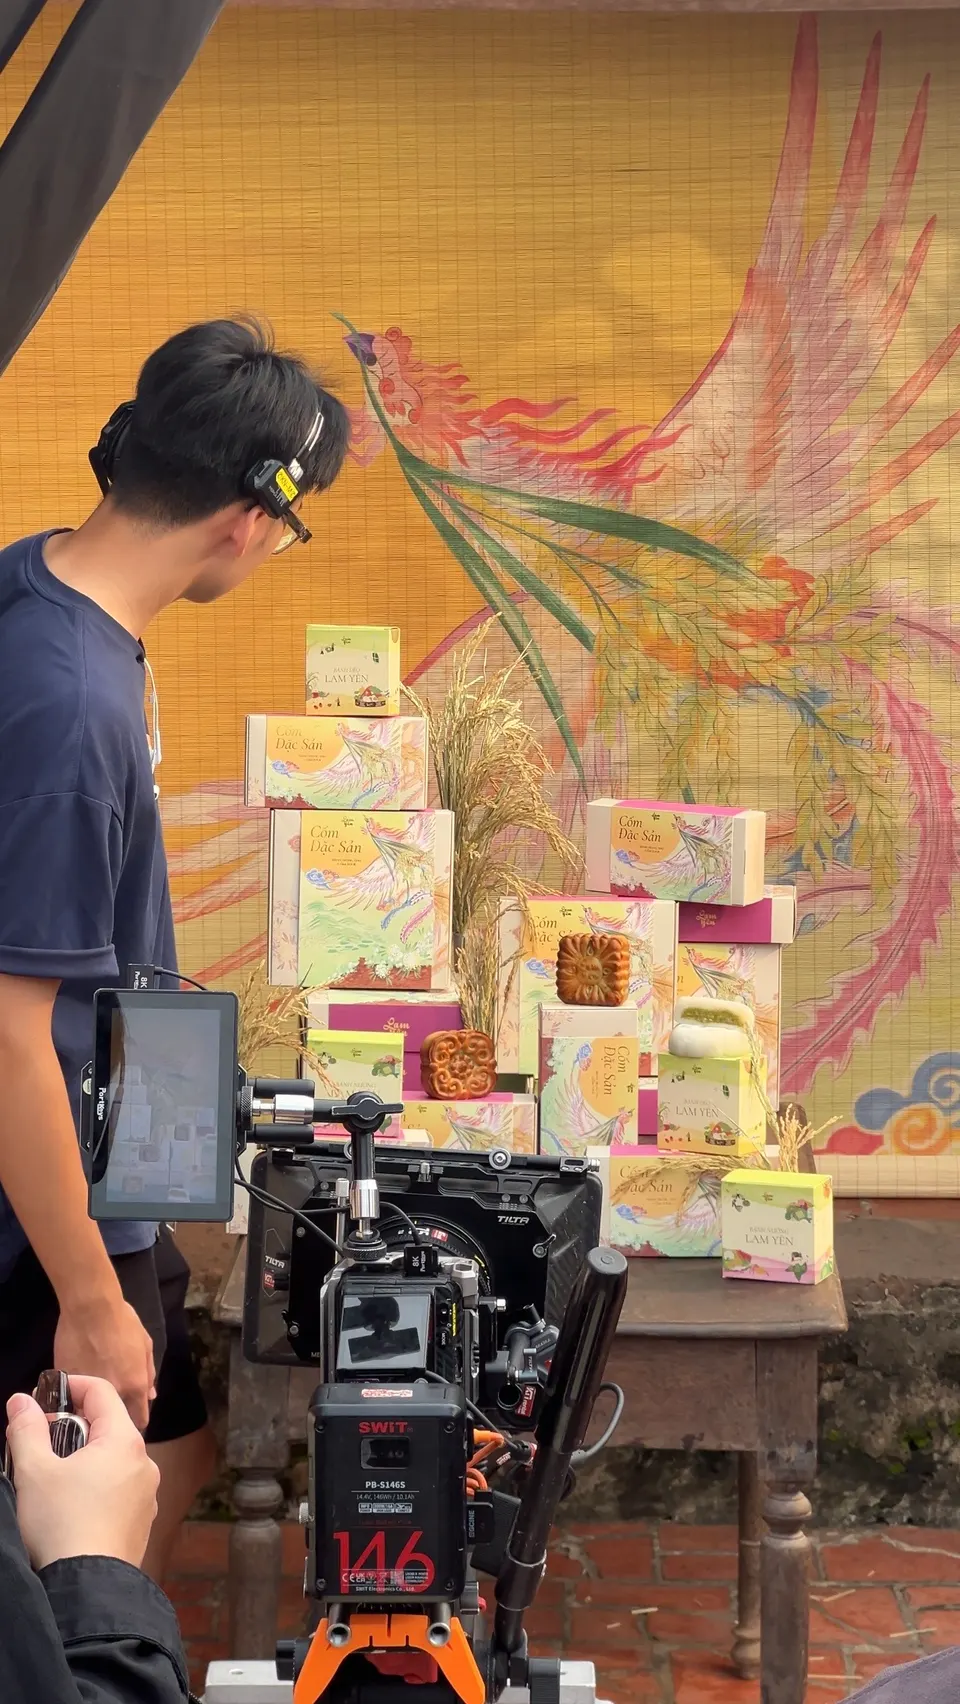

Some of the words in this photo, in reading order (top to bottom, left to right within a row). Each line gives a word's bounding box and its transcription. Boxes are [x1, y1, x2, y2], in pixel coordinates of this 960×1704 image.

[325, 674, 347, 683] LAM
[140, 976, 148, 988] 8K
[497, 1215, 530, 1225] TILTA
[745, 1234, 769, 1245] LAM
[264, 1254, 285, 1269] TILTA
[412, 1256, 420, 1267] 8K
[365, 1481, 406, 1489] PB-S146S
[333, 1530, 435, 1594] 146
